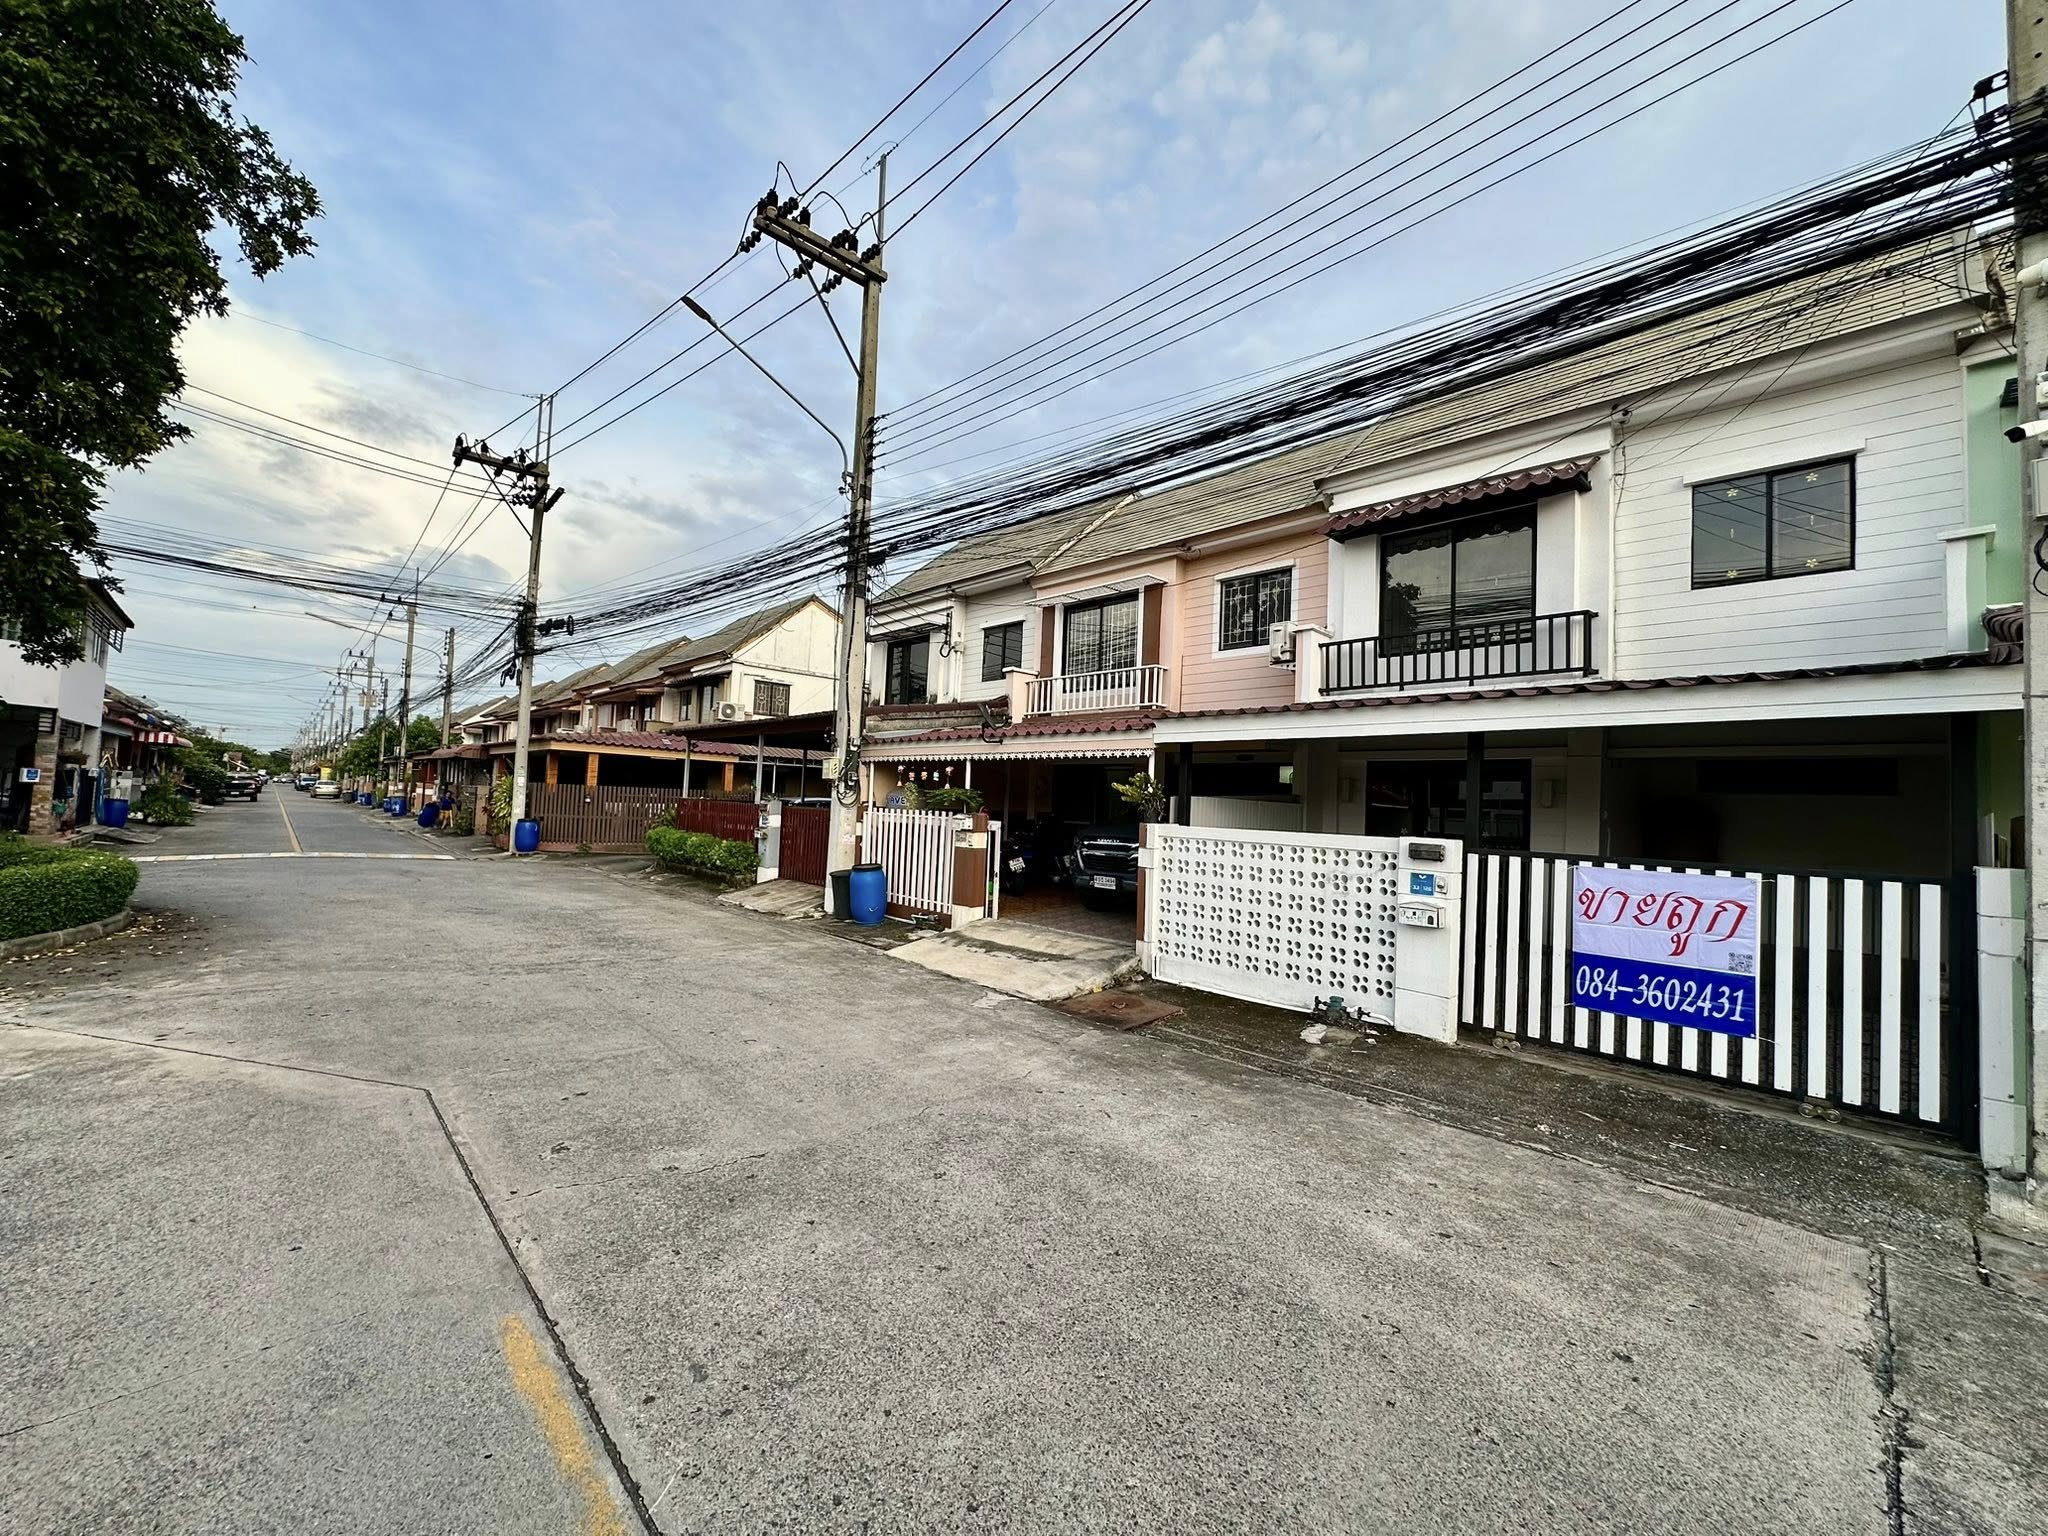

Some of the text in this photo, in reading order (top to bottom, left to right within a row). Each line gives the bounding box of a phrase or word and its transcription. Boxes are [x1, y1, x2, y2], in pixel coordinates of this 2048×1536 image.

[1578, 886, 1749, 957] ขายถูก
[1575, 965, 1745, 1022] 084-3602431
